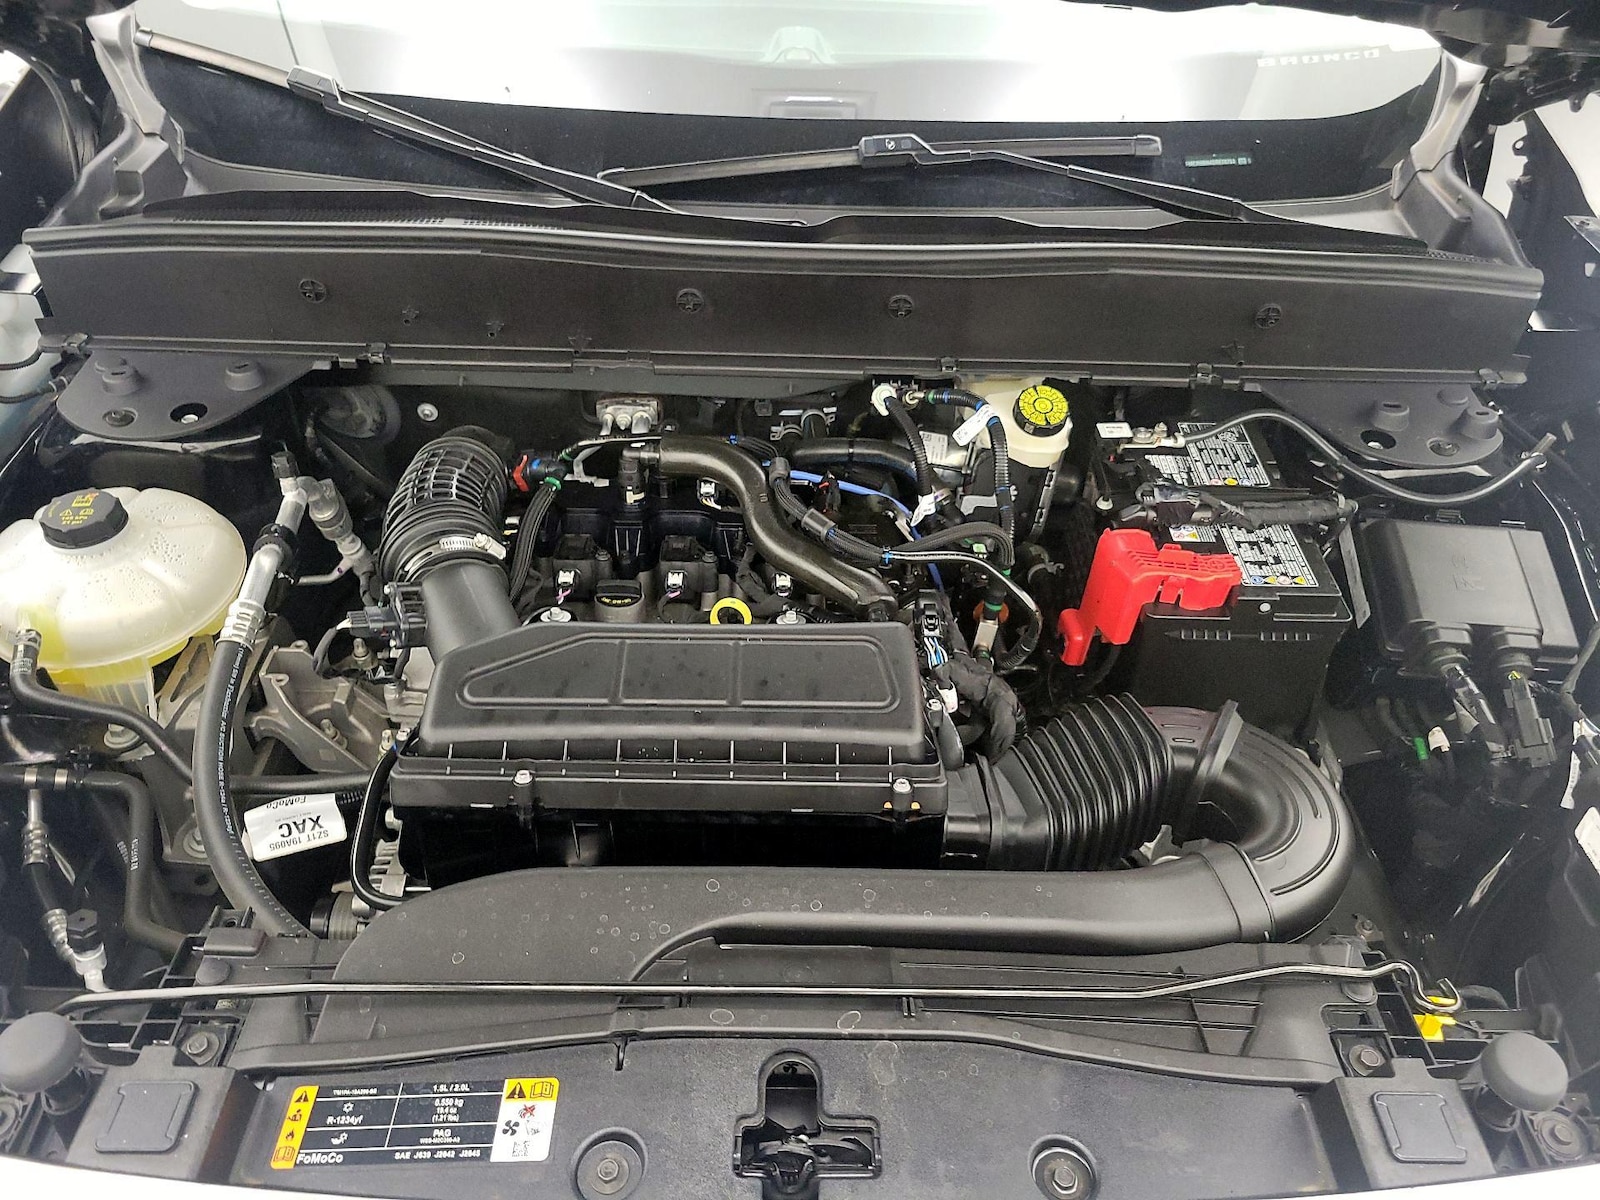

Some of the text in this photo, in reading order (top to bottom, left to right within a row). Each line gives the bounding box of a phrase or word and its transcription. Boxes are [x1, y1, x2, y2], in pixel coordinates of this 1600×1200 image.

[1256, 48, 1380, 68] BRONCO
[217, 732, 226, 761] SUCTION
[217, 762, 225, 780] HOSE
[266, 795, 307, 810] FoMoCo
[278, 814, 324, 838] XAC
[269, 836, 302, 852] 19A095
[454, 1083, 470, 1091] 2.0L
[326, 1115, 363, 1125] R-1234yf
[296, 1152, 344, 1164] FoMoCo
[394, 1151, 411, 1159] SAE
